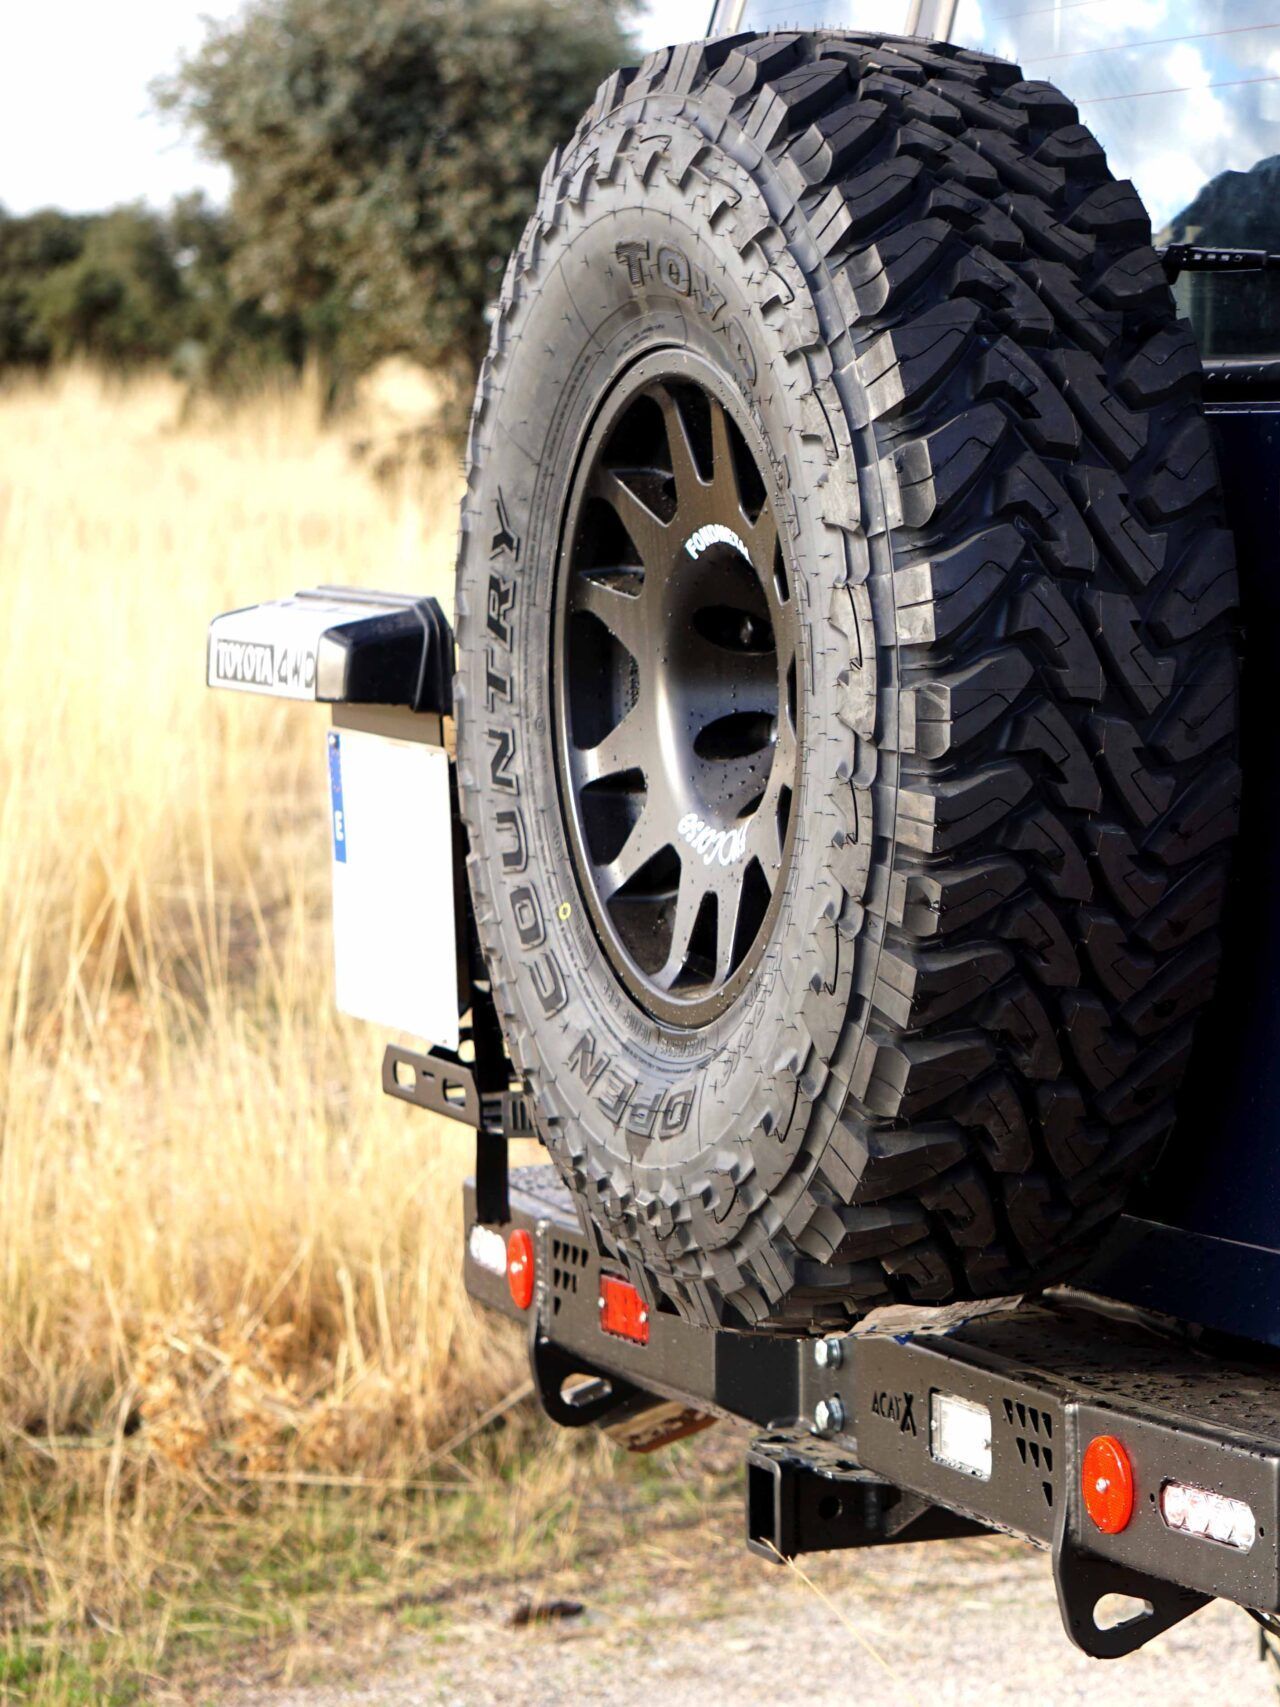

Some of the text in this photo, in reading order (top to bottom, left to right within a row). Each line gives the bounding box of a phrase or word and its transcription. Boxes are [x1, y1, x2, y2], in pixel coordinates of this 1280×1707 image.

[217, 639, 274, 687] TOYOTA
[484, 484, 569, 1020] COUNTRY
[567, 1029, 697, 1143] OPEN
